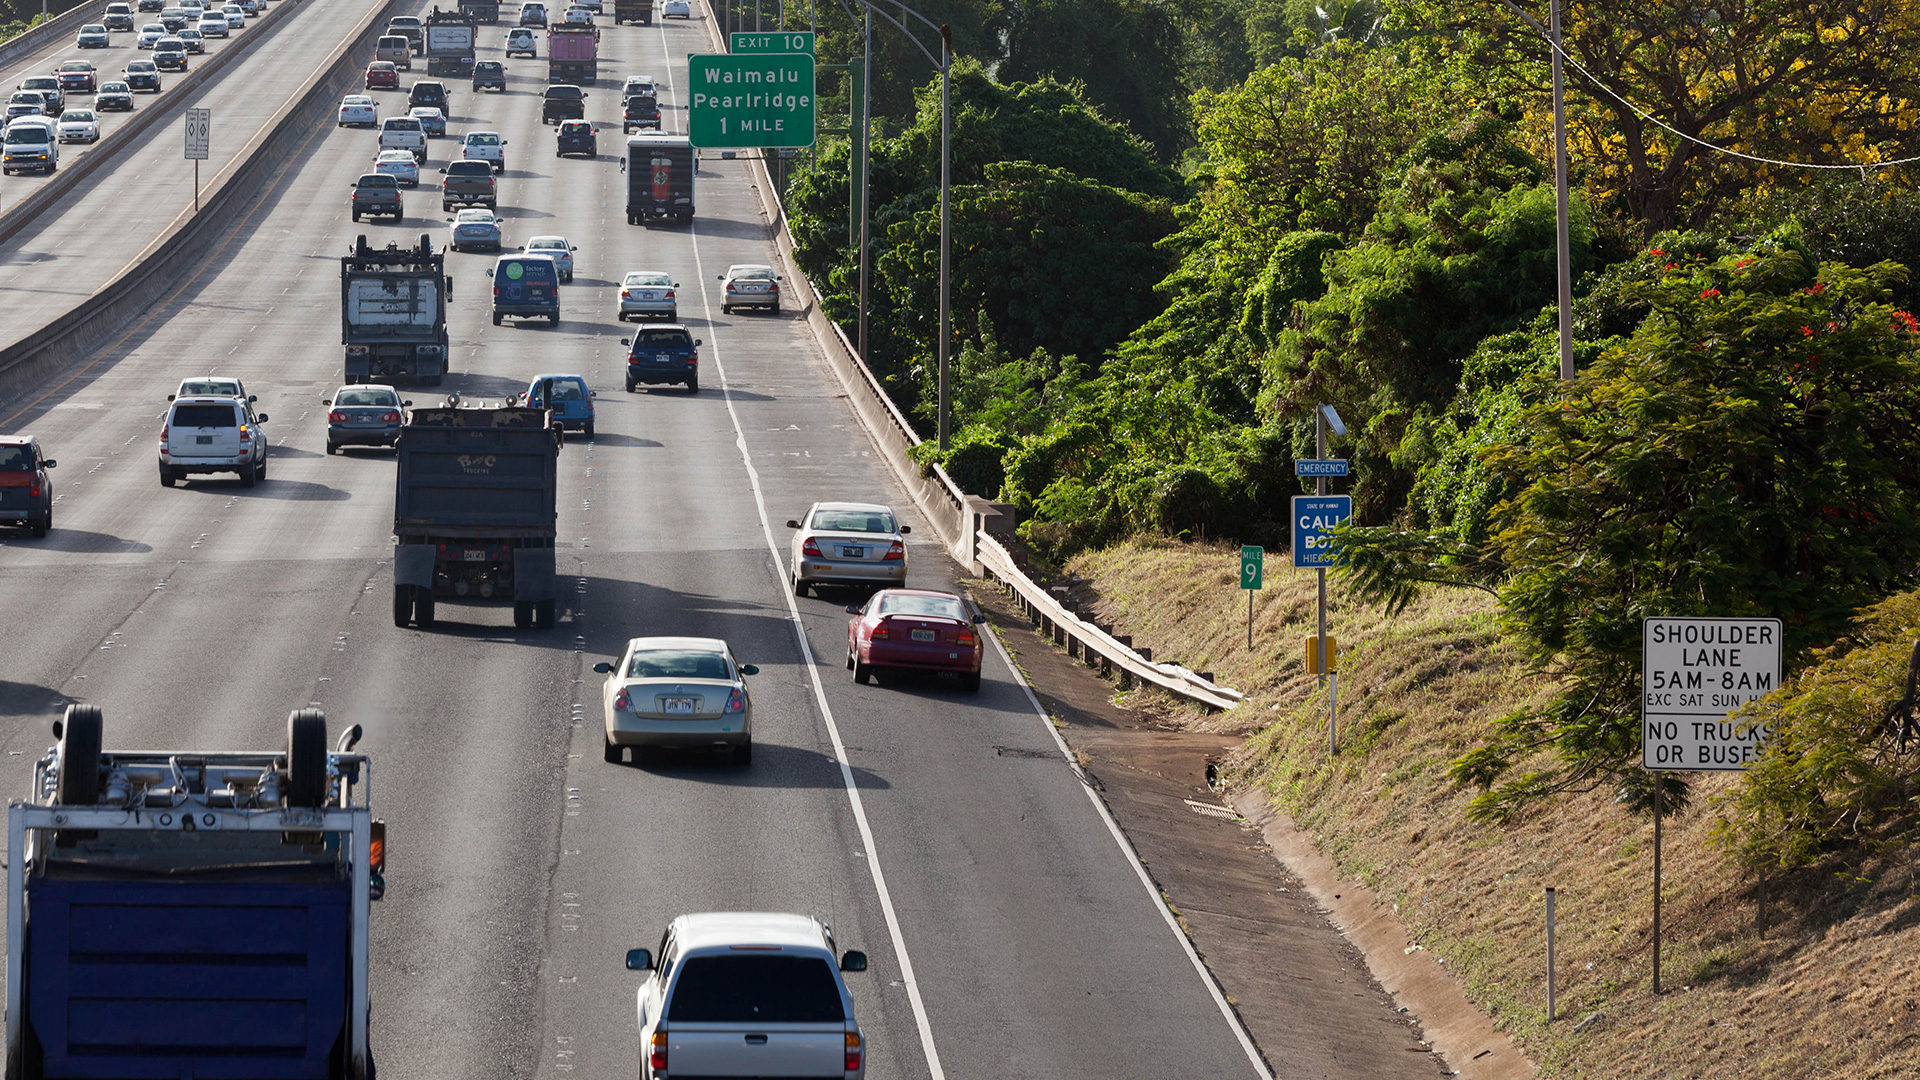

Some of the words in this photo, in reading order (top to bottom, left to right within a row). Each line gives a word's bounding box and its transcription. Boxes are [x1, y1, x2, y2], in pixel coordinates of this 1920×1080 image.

[738, 37, 771, 48] EXIT
[784, 35, 804, 50] 10
[705, 68, 798, 83] Waimalu
[694, 92, 809, 112] Pearlridge
[720, 117, 726, 134] 1
[741, 119, 784, 131] MILE
[525, 265, 546, 273] factory
[1299, 463, 1346, 473] EMERGENCY
[1243, 551, 1261, 560] MILE
[1245, 563, 1256, 583] 9
[1653, 624, 1773, 645] SHOULDER
[1683, 648, 1741, 667] LANE
[1647, 693, 1672, 706] EXC
[1679, 693, 1704, 706] SAT
[1711, 694, 1740, 707] SUN
[1649, 721, 1678, 740] NO
[1656, 744, 1683, 763] OR
